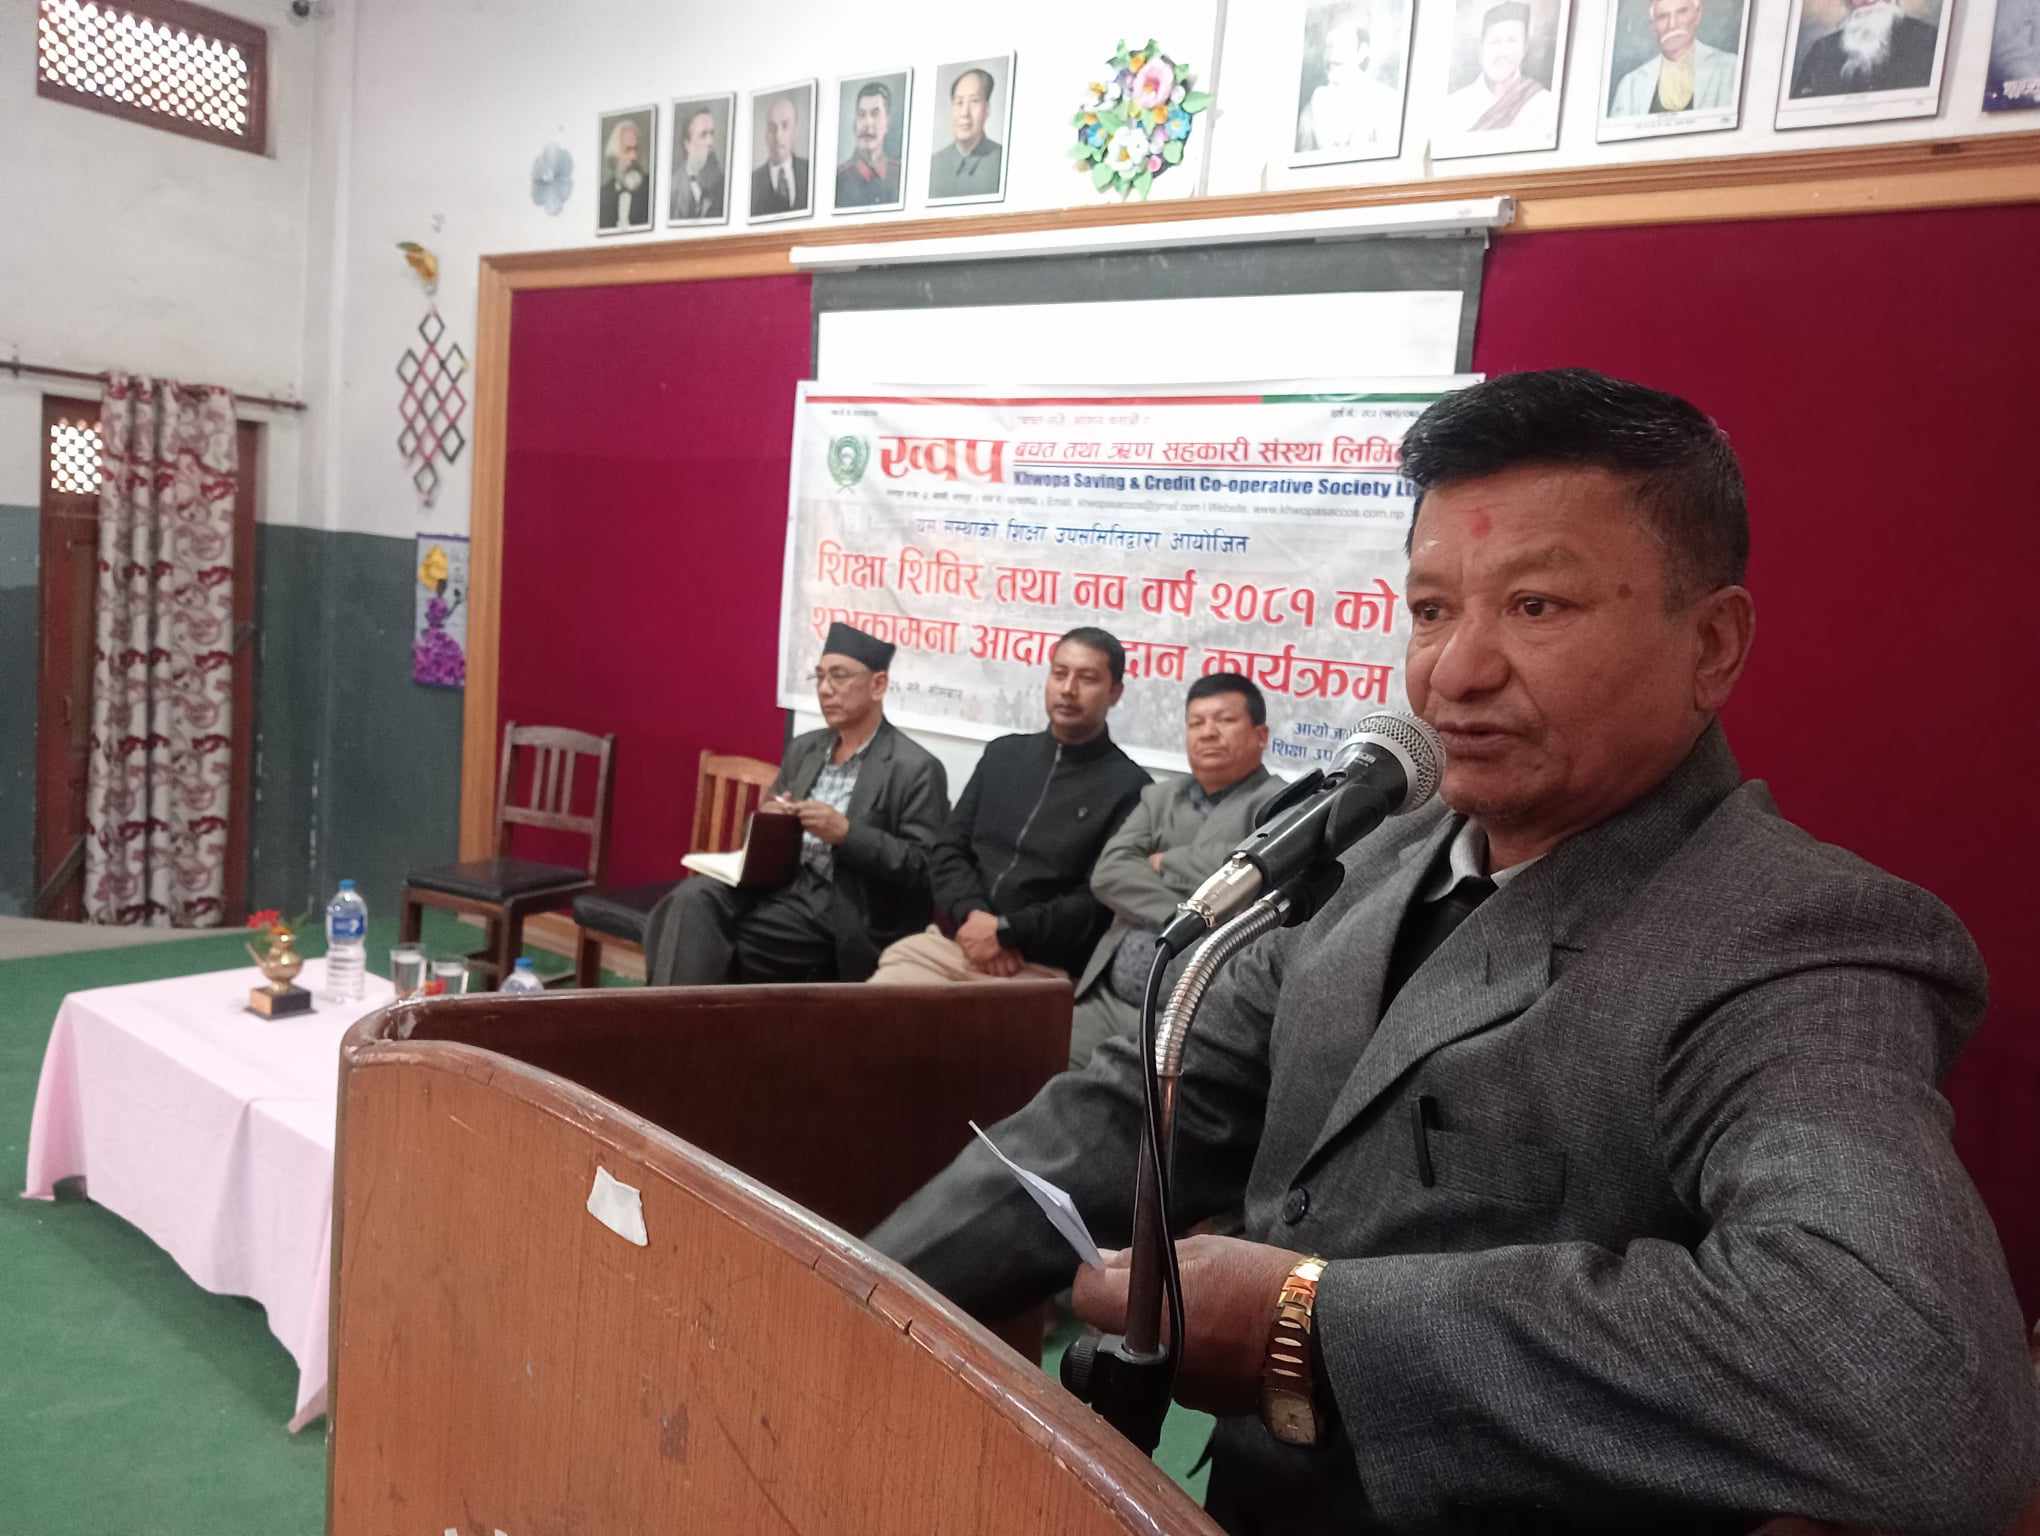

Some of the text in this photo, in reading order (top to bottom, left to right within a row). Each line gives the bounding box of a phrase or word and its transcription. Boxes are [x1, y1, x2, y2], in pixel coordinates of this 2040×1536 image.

[1063, 442, 1101, 460] तथा
[1162, 436, 1250, 463] सहकारी
[1258, 438, 1324, 464] संस्था
[1332, 435, 1403, 465] लिमि
[1013, 471, 1070, 489] Khwopa
[1074, 473, 1126, 491] Saving
[1129, 476, 1140, 490] &
[1145, 474, 1196, 492] Credit
[1200, 476, 1313, 495] Co-operative
[1318, 478, 1392, 498] Society
[1006, 517, 1048, 543] शिक्षा
[1055, 521, 1161, 551] उपसमितिद्वारा
[1169, 527, 1250, 553] आयोजित
[818, 539, 1399, 634] शिक्षा शिविर तथा नव वर्ष २०८१ को
[1202, 644, 1394, 705] कार्यक्रम
